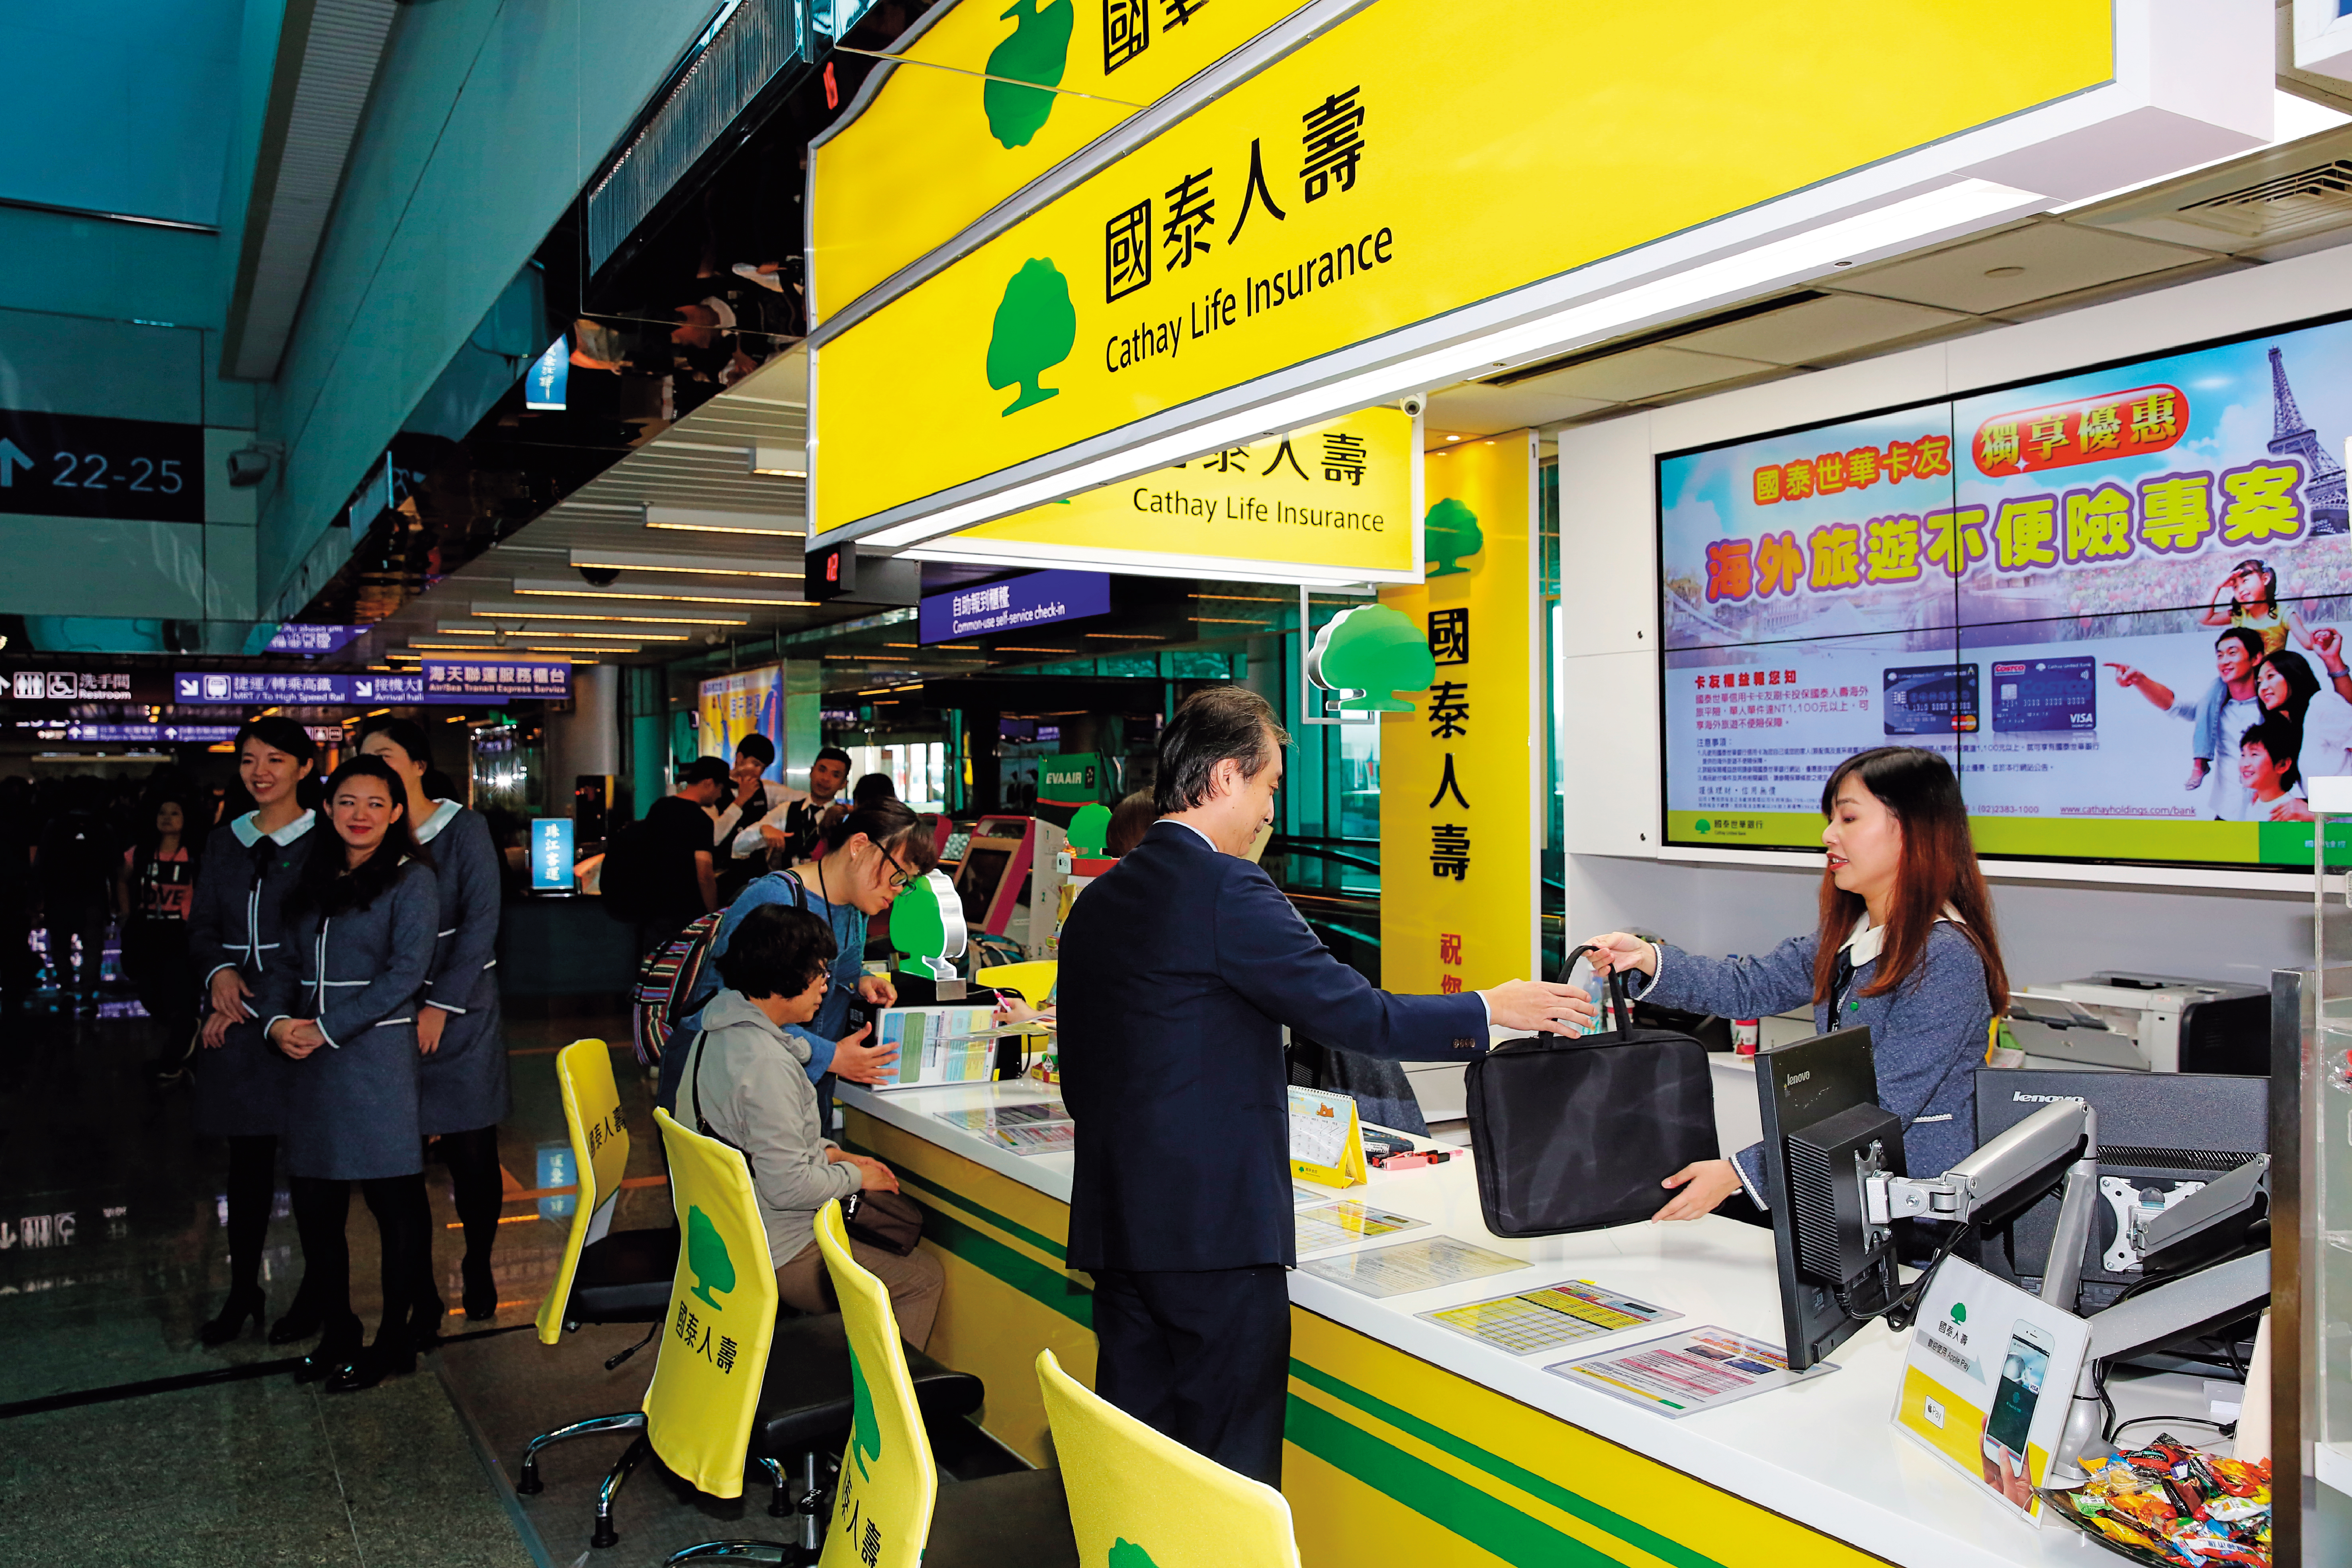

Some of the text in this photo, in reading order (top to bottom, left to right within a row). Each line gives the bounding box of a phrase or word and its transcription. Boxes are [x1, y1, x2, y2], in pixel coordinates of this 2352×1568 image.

[1105, 85, 1365, 303] 國泰人壽
[1106, 227, 1393, 372] Cathay Life Insurance
[1980, 392, 2178, 470] 獨享優惠
[53, 451, 182, 494] 22-25
[1169, 433, 1367, 486] 泰人壽
[1755, 436, 1950, 503] 國泰世華卡友
[1134, 488, 1385, 532] Cathay Life Insurance
[1706, 460, 2305, 604] 海外旅遊不便險專案
[953, 602, 1065, 634] Common-use self-service check-in
[79, 689, 131, 699] Restroom
[80, 673, 130, 689] 洗手間
[375, 678, 423, 692] 接機大
[428, 683, 566, 694] Air/Sea Transit Express Service
[233, 692, 253, 700] MRT
[262, 692, 274, 701] To
[277, 693, 297, 703] High
[298, 692, 327, 703] Speed
[328, 692, 345, 701] Rail
[374, 693, 405, 701] Arrival
[2070, 713, 2093, 723] VISA
[1428, 608, 1470, 881] 國泰人壽
[2060, 805, 2196, 816] www.cathayholdings.com/bank
[1787, 1071, 1810, 1086] lenovo
[675, 1301, 738, 1375] 國泰人壽
[1938, 1321, 1968, 1346] 國泰人壽
[1927, 1338, 1970, 1372] 歡迎使用 Apple Pay
[2030, 1383, 2039, 1392] VISA
[1933, 1406, 1941, 1421] Pay
